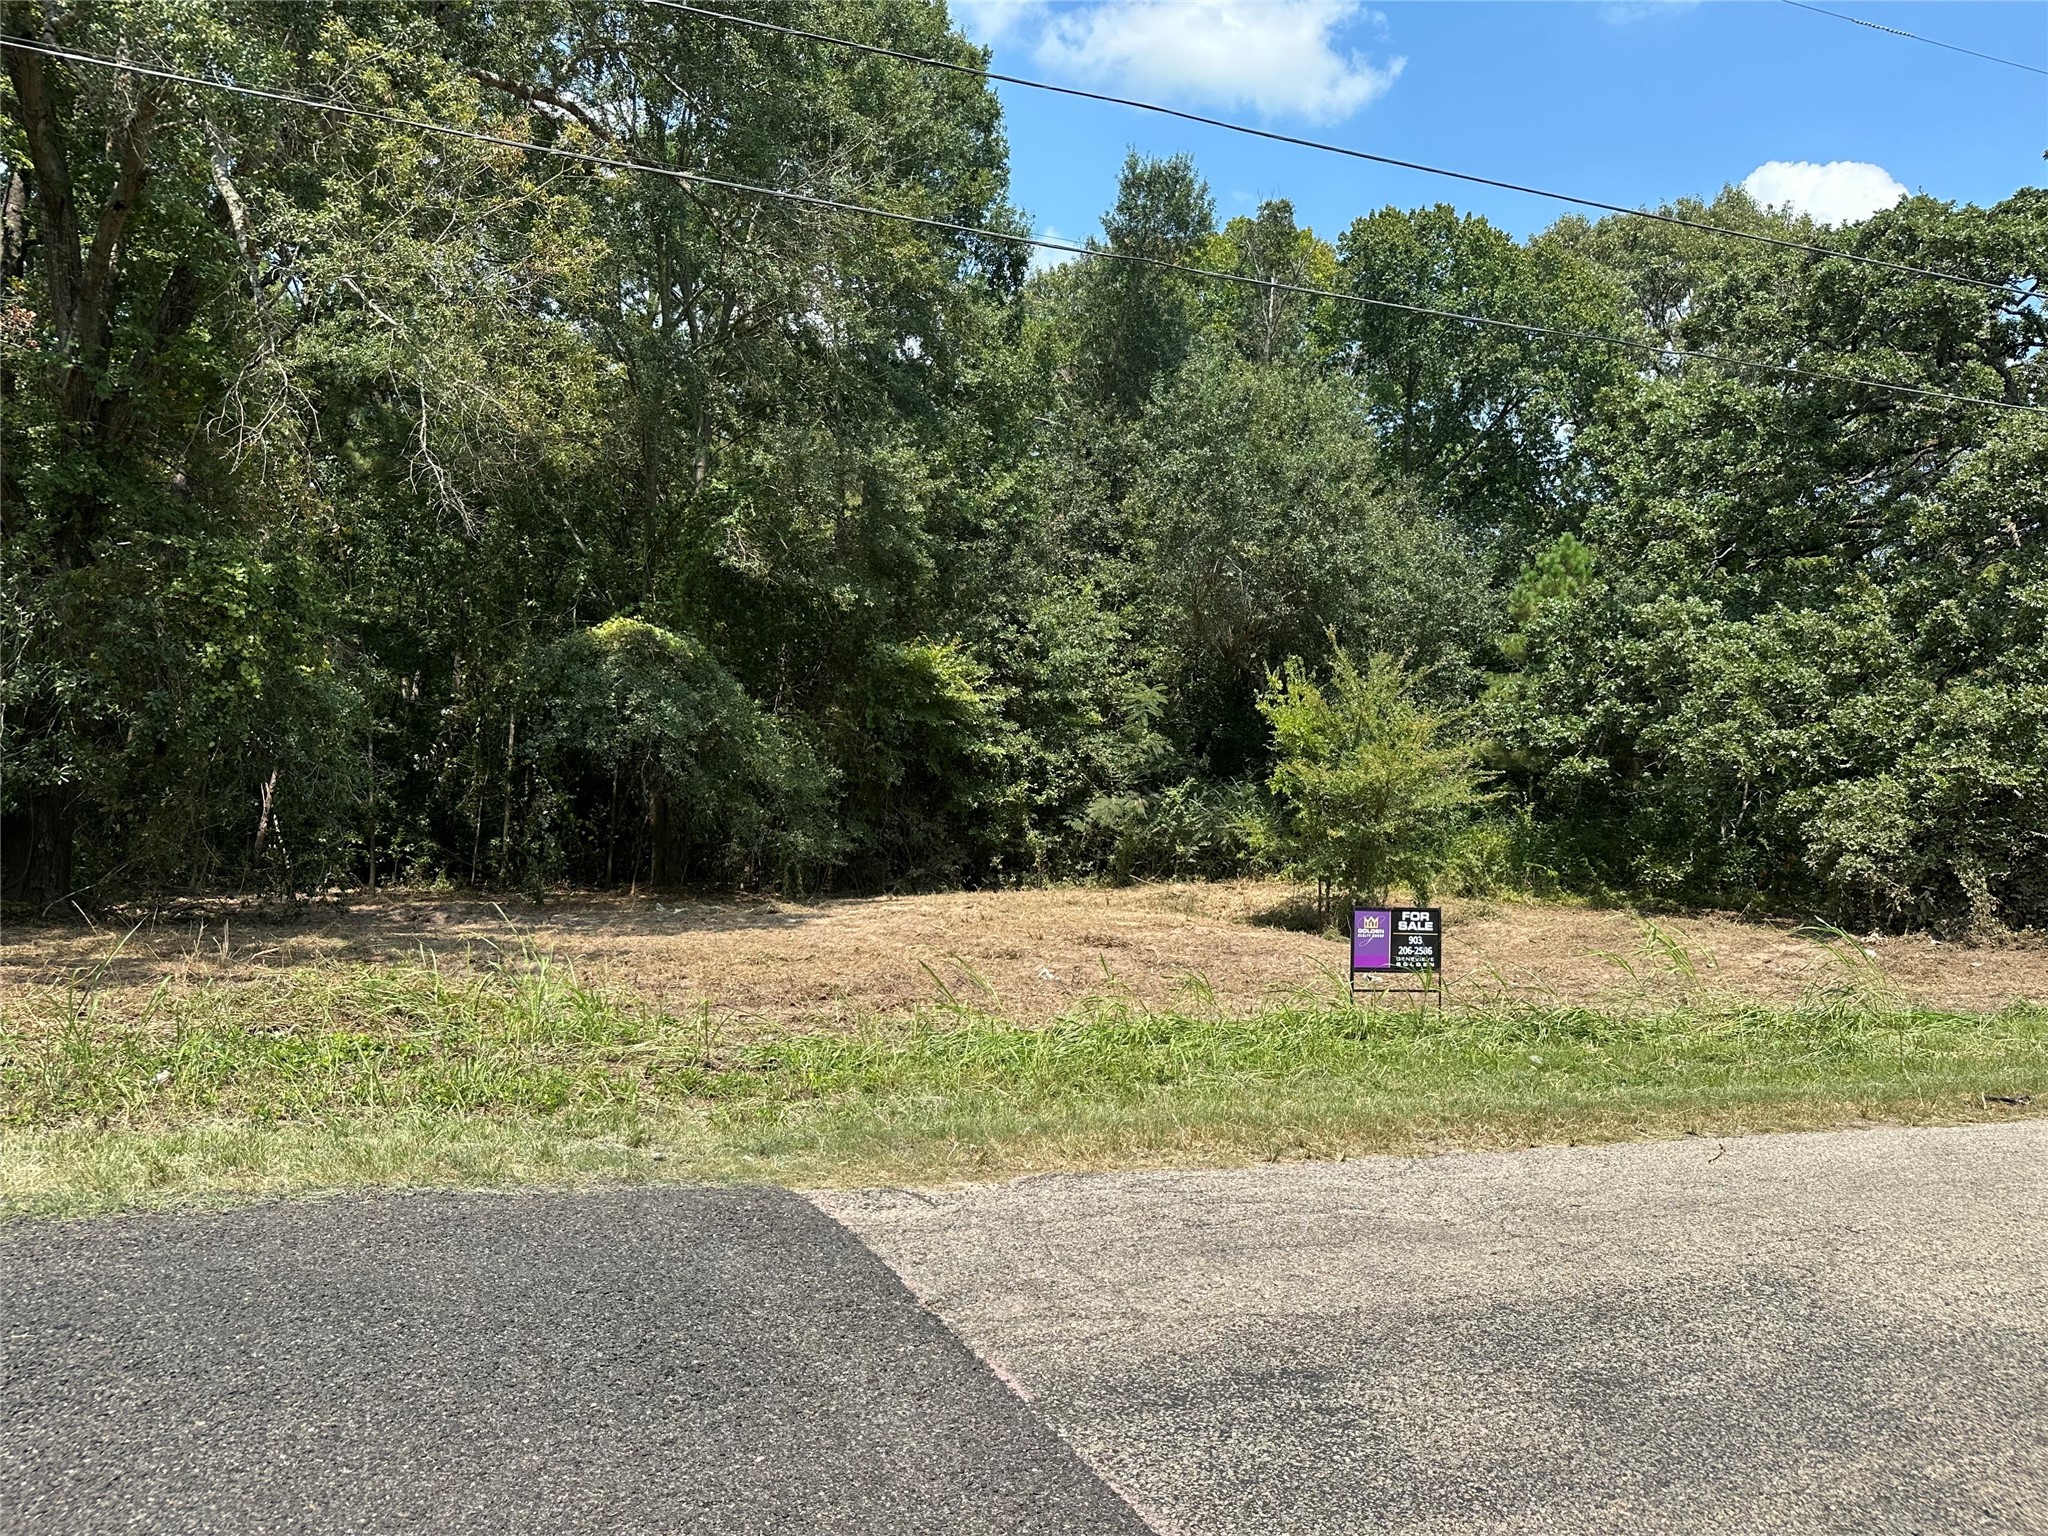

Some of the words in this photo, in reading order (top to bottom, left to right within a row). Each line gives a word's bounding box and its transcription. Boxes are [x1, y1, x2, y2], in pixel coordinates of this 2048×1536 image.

[1401, 911, 1430, 921] FOR
[1397, 921, 1434, 931] SALE
[1408, 935, 1423, 945] 903
[1397, 945, 1433, 955] 206-2506
